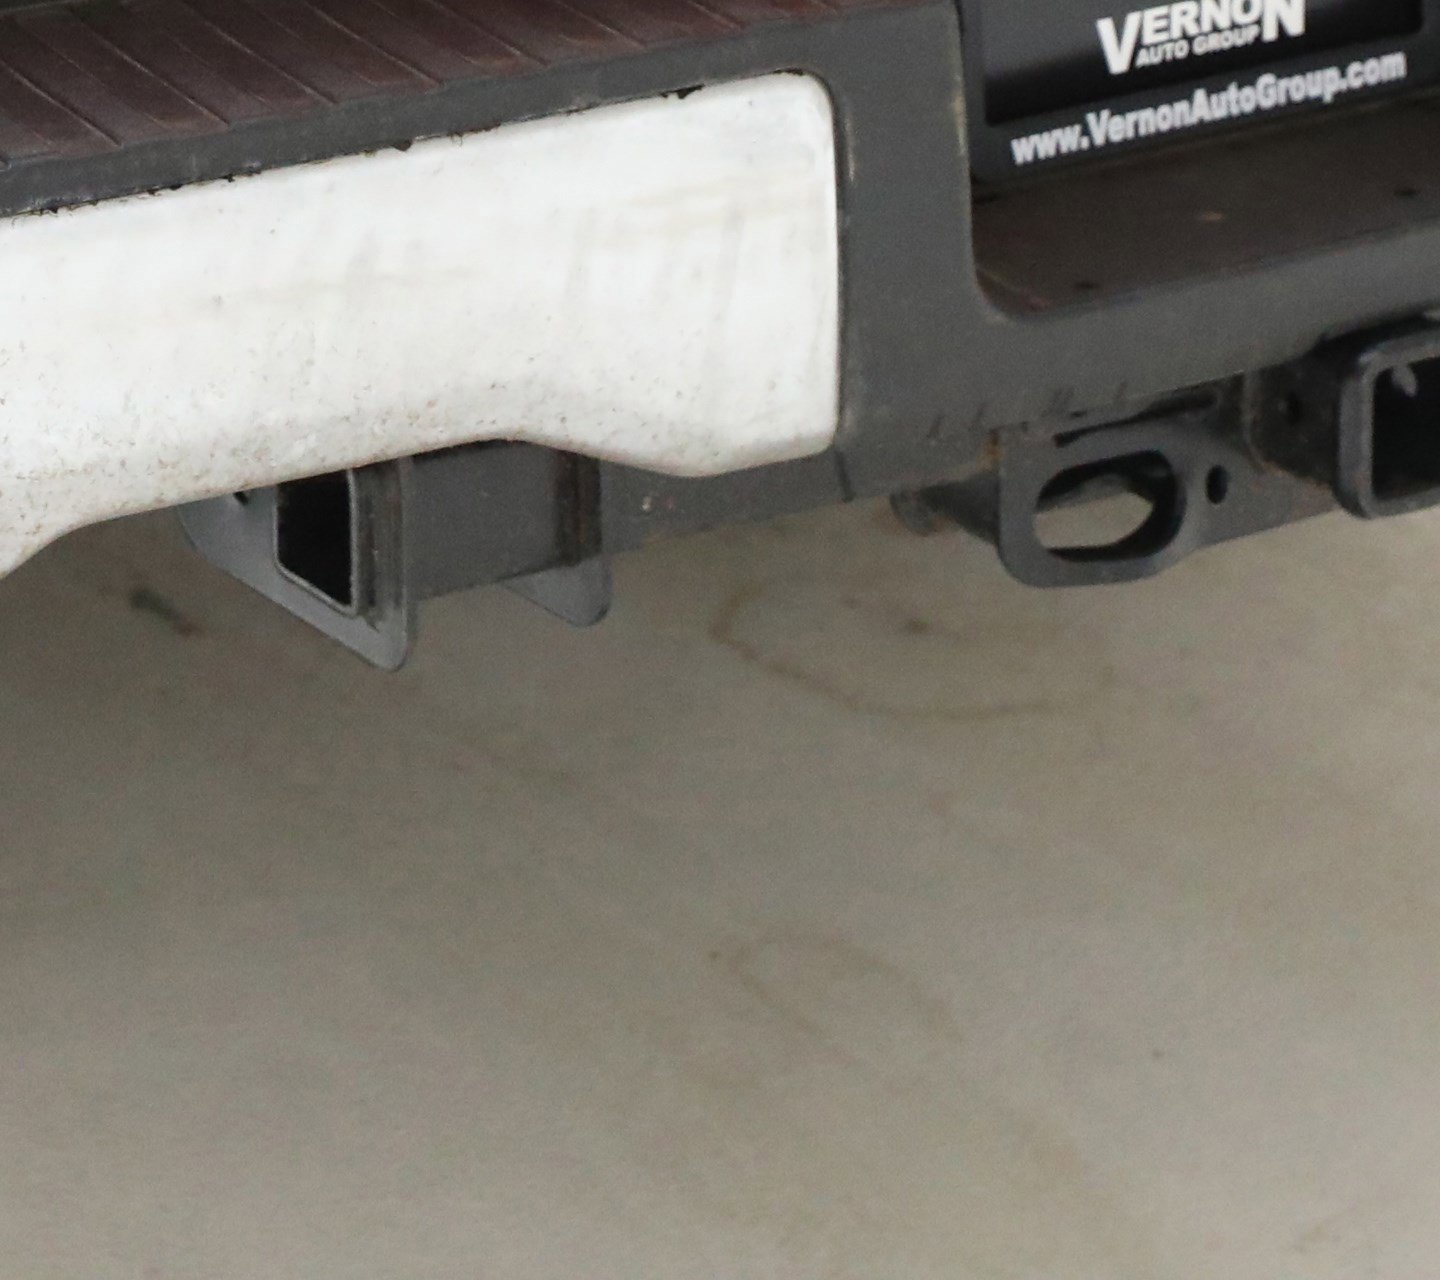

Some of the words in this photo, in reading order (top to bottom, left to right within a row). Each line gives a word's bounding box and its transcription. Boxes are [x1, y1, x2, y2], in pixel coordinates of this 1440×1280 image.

[1134, 39, 1190, 69] AUTO
[1191, 23, 1260, 56] GROUP
[1010, 50, 1407, 166] www.VernonAutoGroup.com
